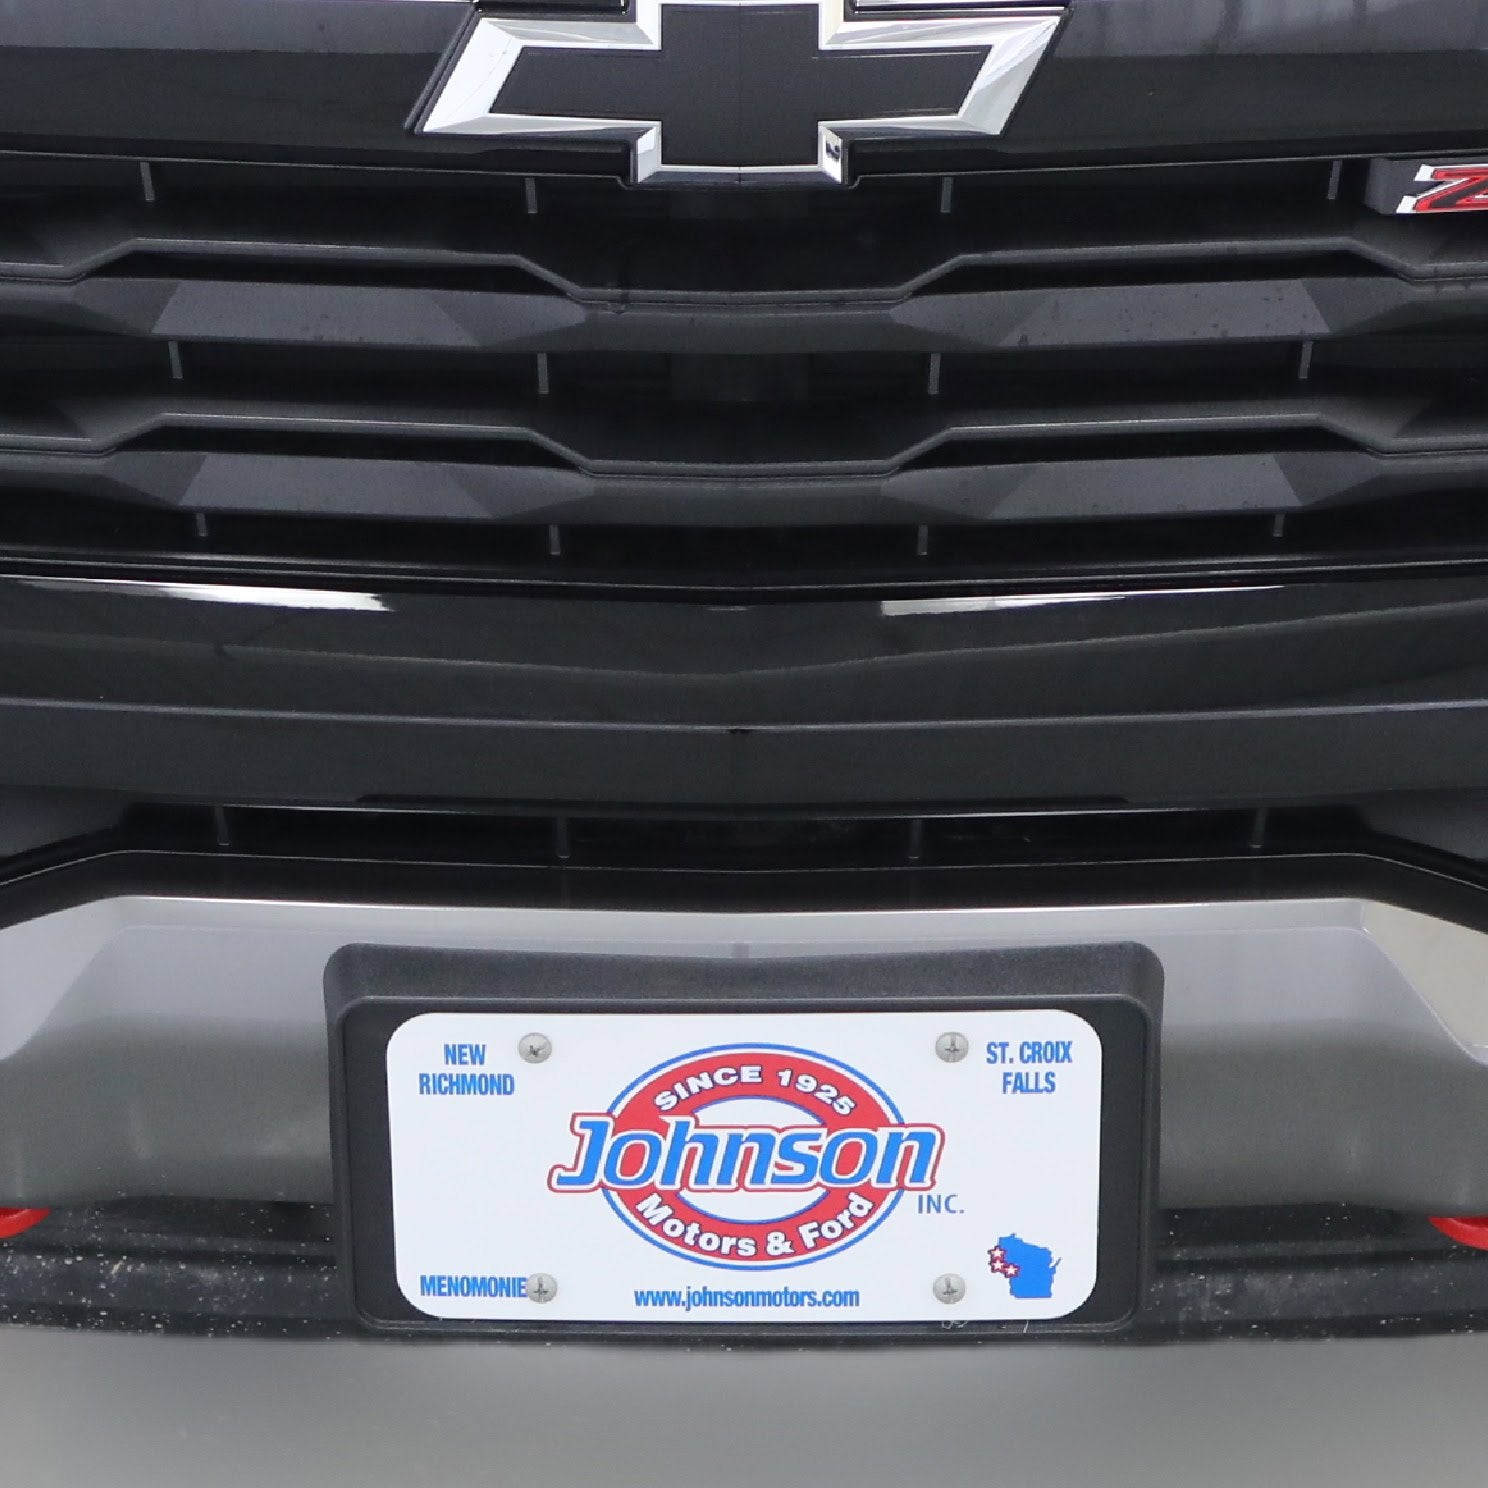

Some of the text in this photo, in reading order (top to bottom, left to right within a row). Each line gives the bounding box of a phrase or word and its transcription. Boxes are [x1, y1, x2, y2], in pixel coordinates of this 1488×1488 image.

[444, 1044, 486, 1065] NEW
[986, 1040, 1073, 1064] ST. CROIX
[419, 1073, 515, 1095] RICHMOND
[654, 1065, 857, 1117] SINCE 1925
[1002, 1071, 1056, 1094] FALLS
[553, 1117, 939, 1188] Johnson
[917, 1194, 964, 1214] INC.
[635, 1192, 875, 1257] Motors & Ford
[420, 1274, 529, 1297] MENOMONIE
[634, 1286, 860, 1312] www.johnsonmotors.com
